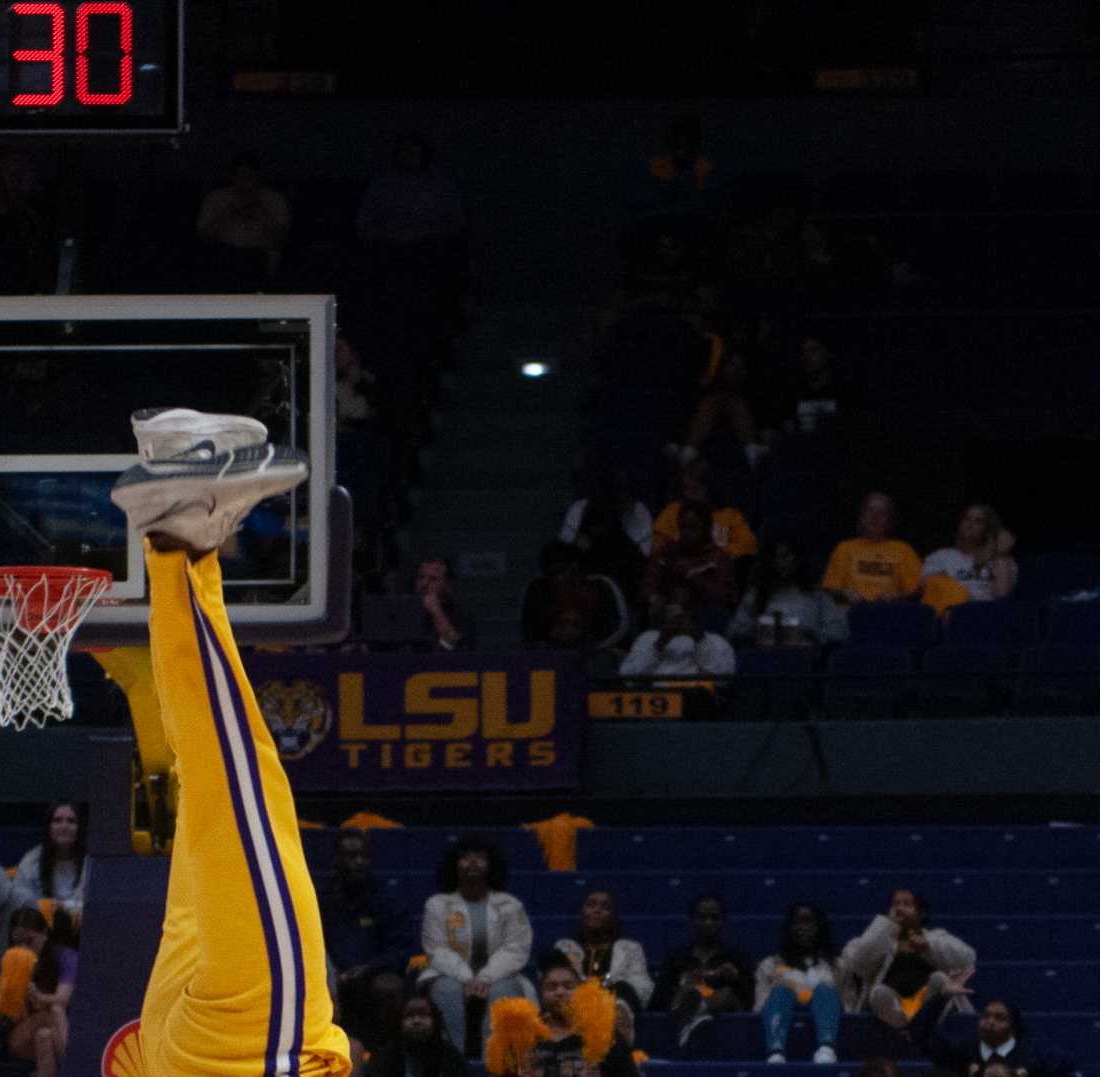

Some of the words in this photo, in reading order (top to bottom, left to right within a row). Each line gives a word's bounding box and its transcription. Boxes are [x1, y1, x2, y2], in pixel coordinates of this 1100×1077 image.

[11, 1, 133, 108] 30
[338, 670, 557, 741] LSU
[609, 692, 668, 716] 119
[340, 742, 557, 769] TIGERS
